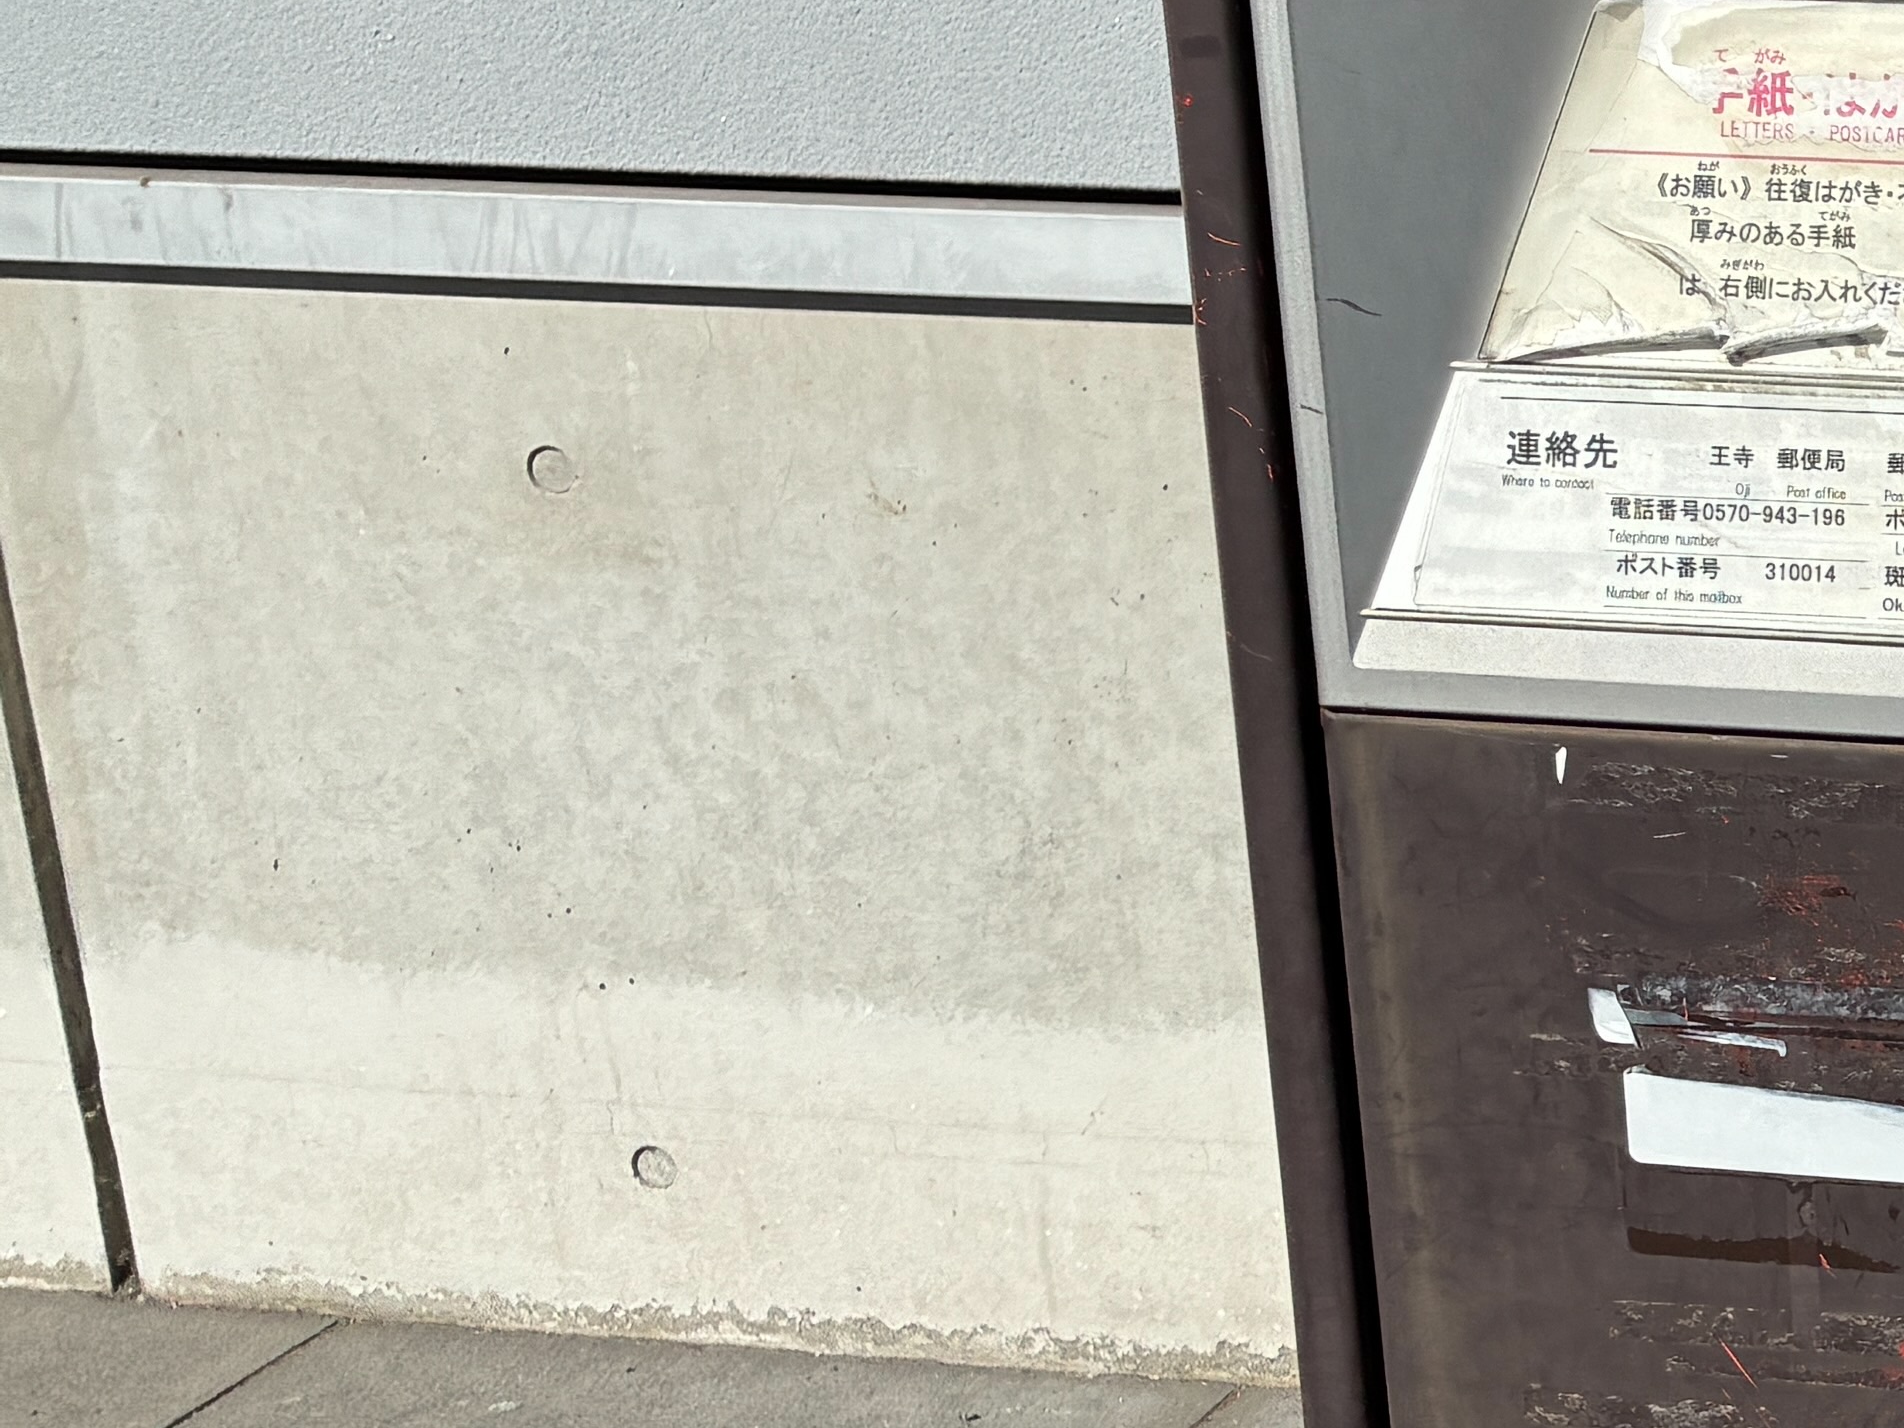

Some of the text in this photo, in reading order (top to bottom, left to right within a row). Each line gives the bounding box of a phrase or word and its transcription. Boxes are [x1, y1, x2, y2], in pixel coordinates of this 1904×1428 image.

[1753, 48, 1787, 65] がみ
[1720, 121, 1794, 140] LETTERS
[1689, 218, 1857, 251] 厚みのある手紙
[1506, 429, 1619, 469] 連絡先
[1709, 445, 1846, 472] 王寺 郵便局
[1609, 529, 1720, 548] Telephone number
[1616, 553, 1837, 583] ポスト番号 310014
[1606, 585, 1649, 601] Number
